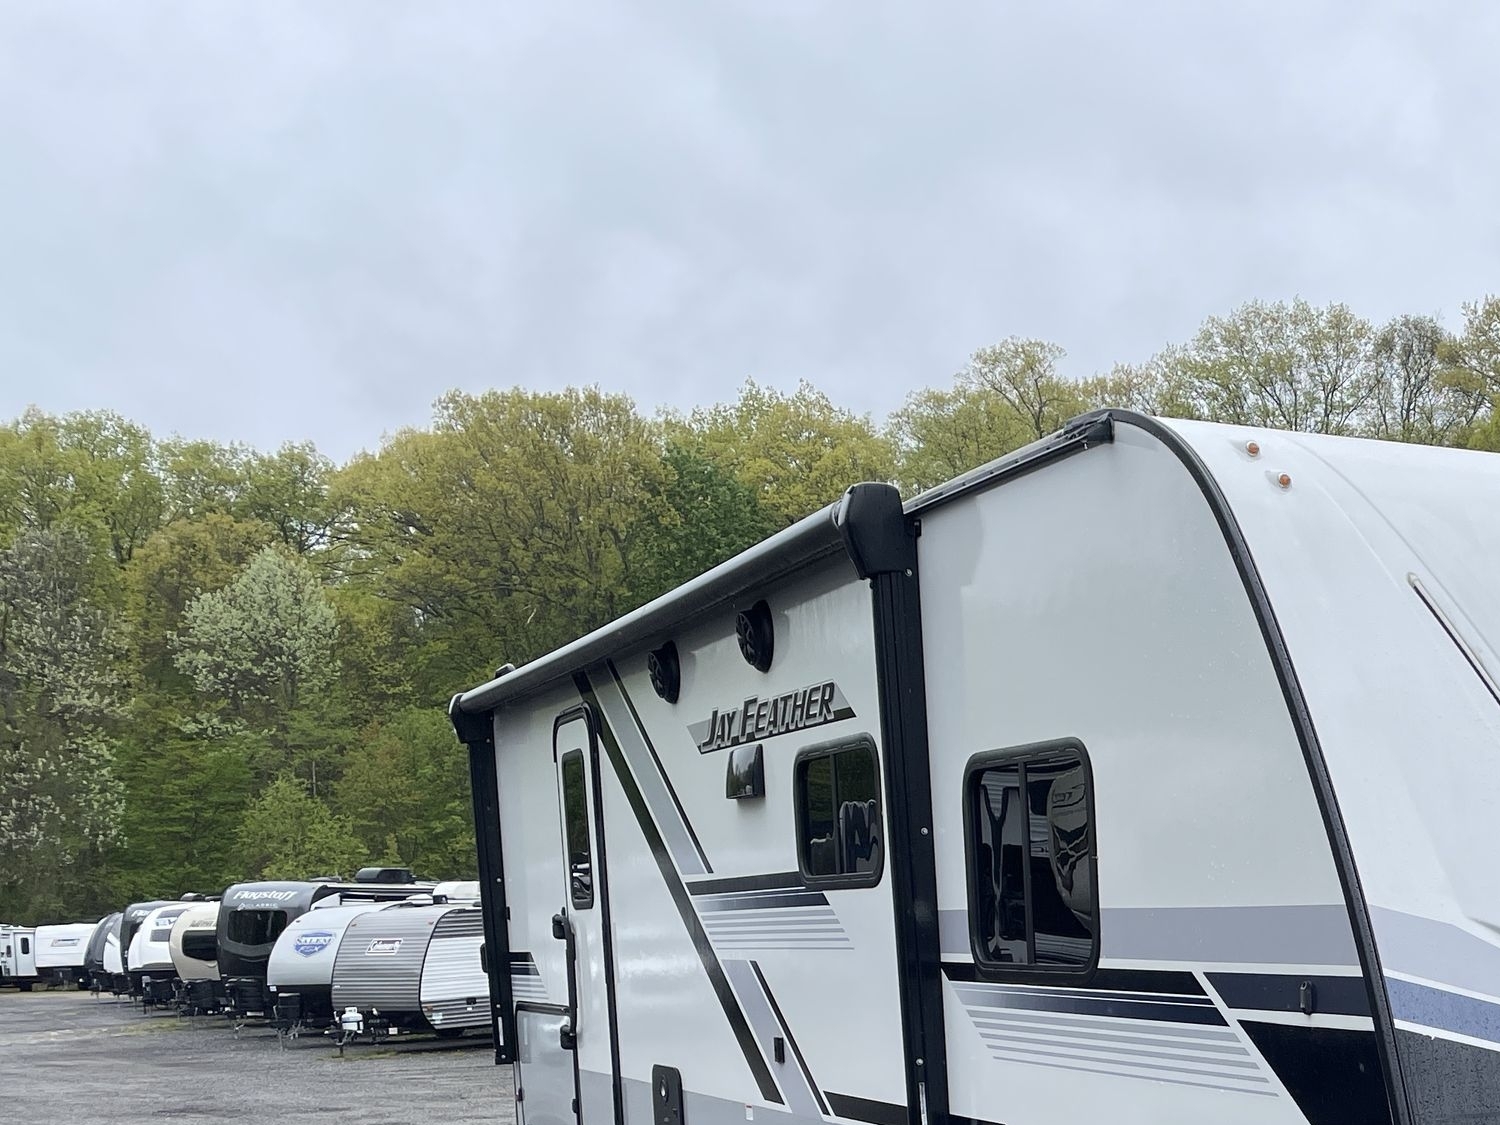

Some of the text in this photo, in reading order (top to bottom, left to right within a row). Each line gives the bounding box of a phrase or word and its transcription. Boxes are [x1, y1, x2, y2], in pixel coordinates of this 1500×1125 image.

[701, 681, 835, 749] JAY FEATHER
[233, 890, 298, 901] Flagstaff
